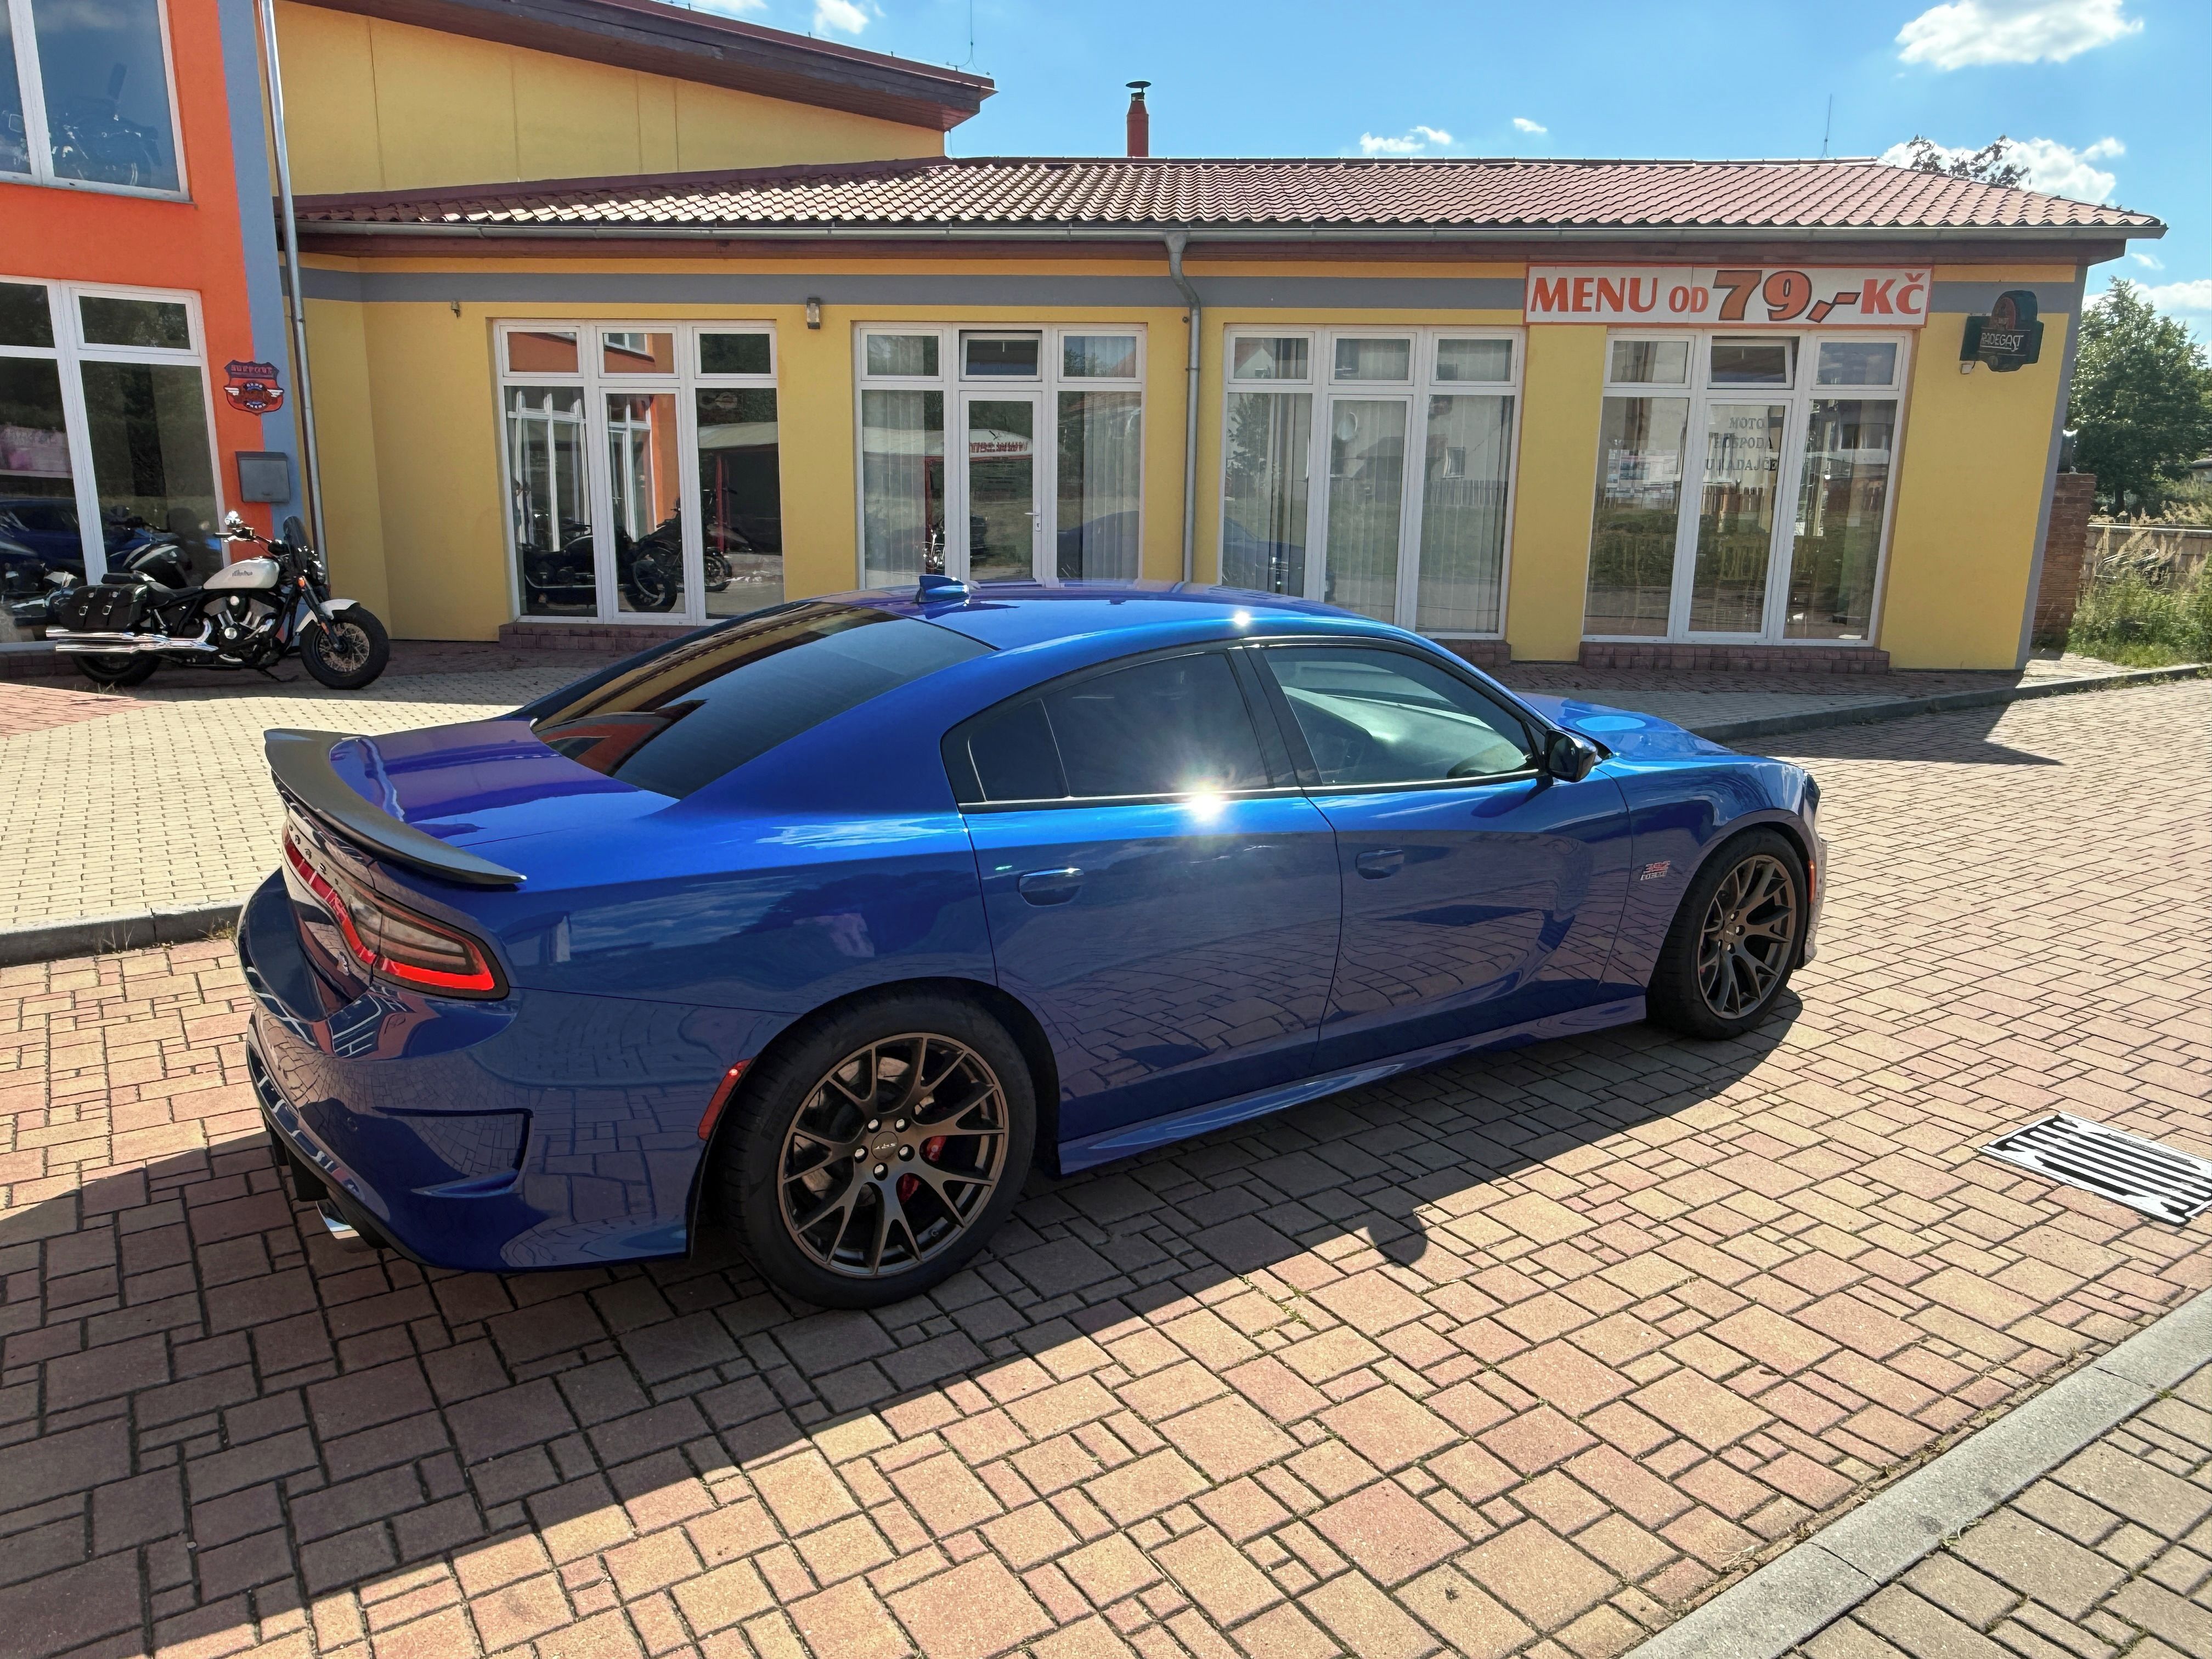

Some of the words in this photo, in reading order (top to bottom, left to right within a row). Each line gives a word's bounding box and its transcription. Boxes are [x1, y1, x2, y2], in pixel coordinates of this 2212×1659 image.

[1530, 277, 1658, 313] MENU
[1668, 286, 1708, 313] OD
[1860, 272, 1926, 314] KČ
